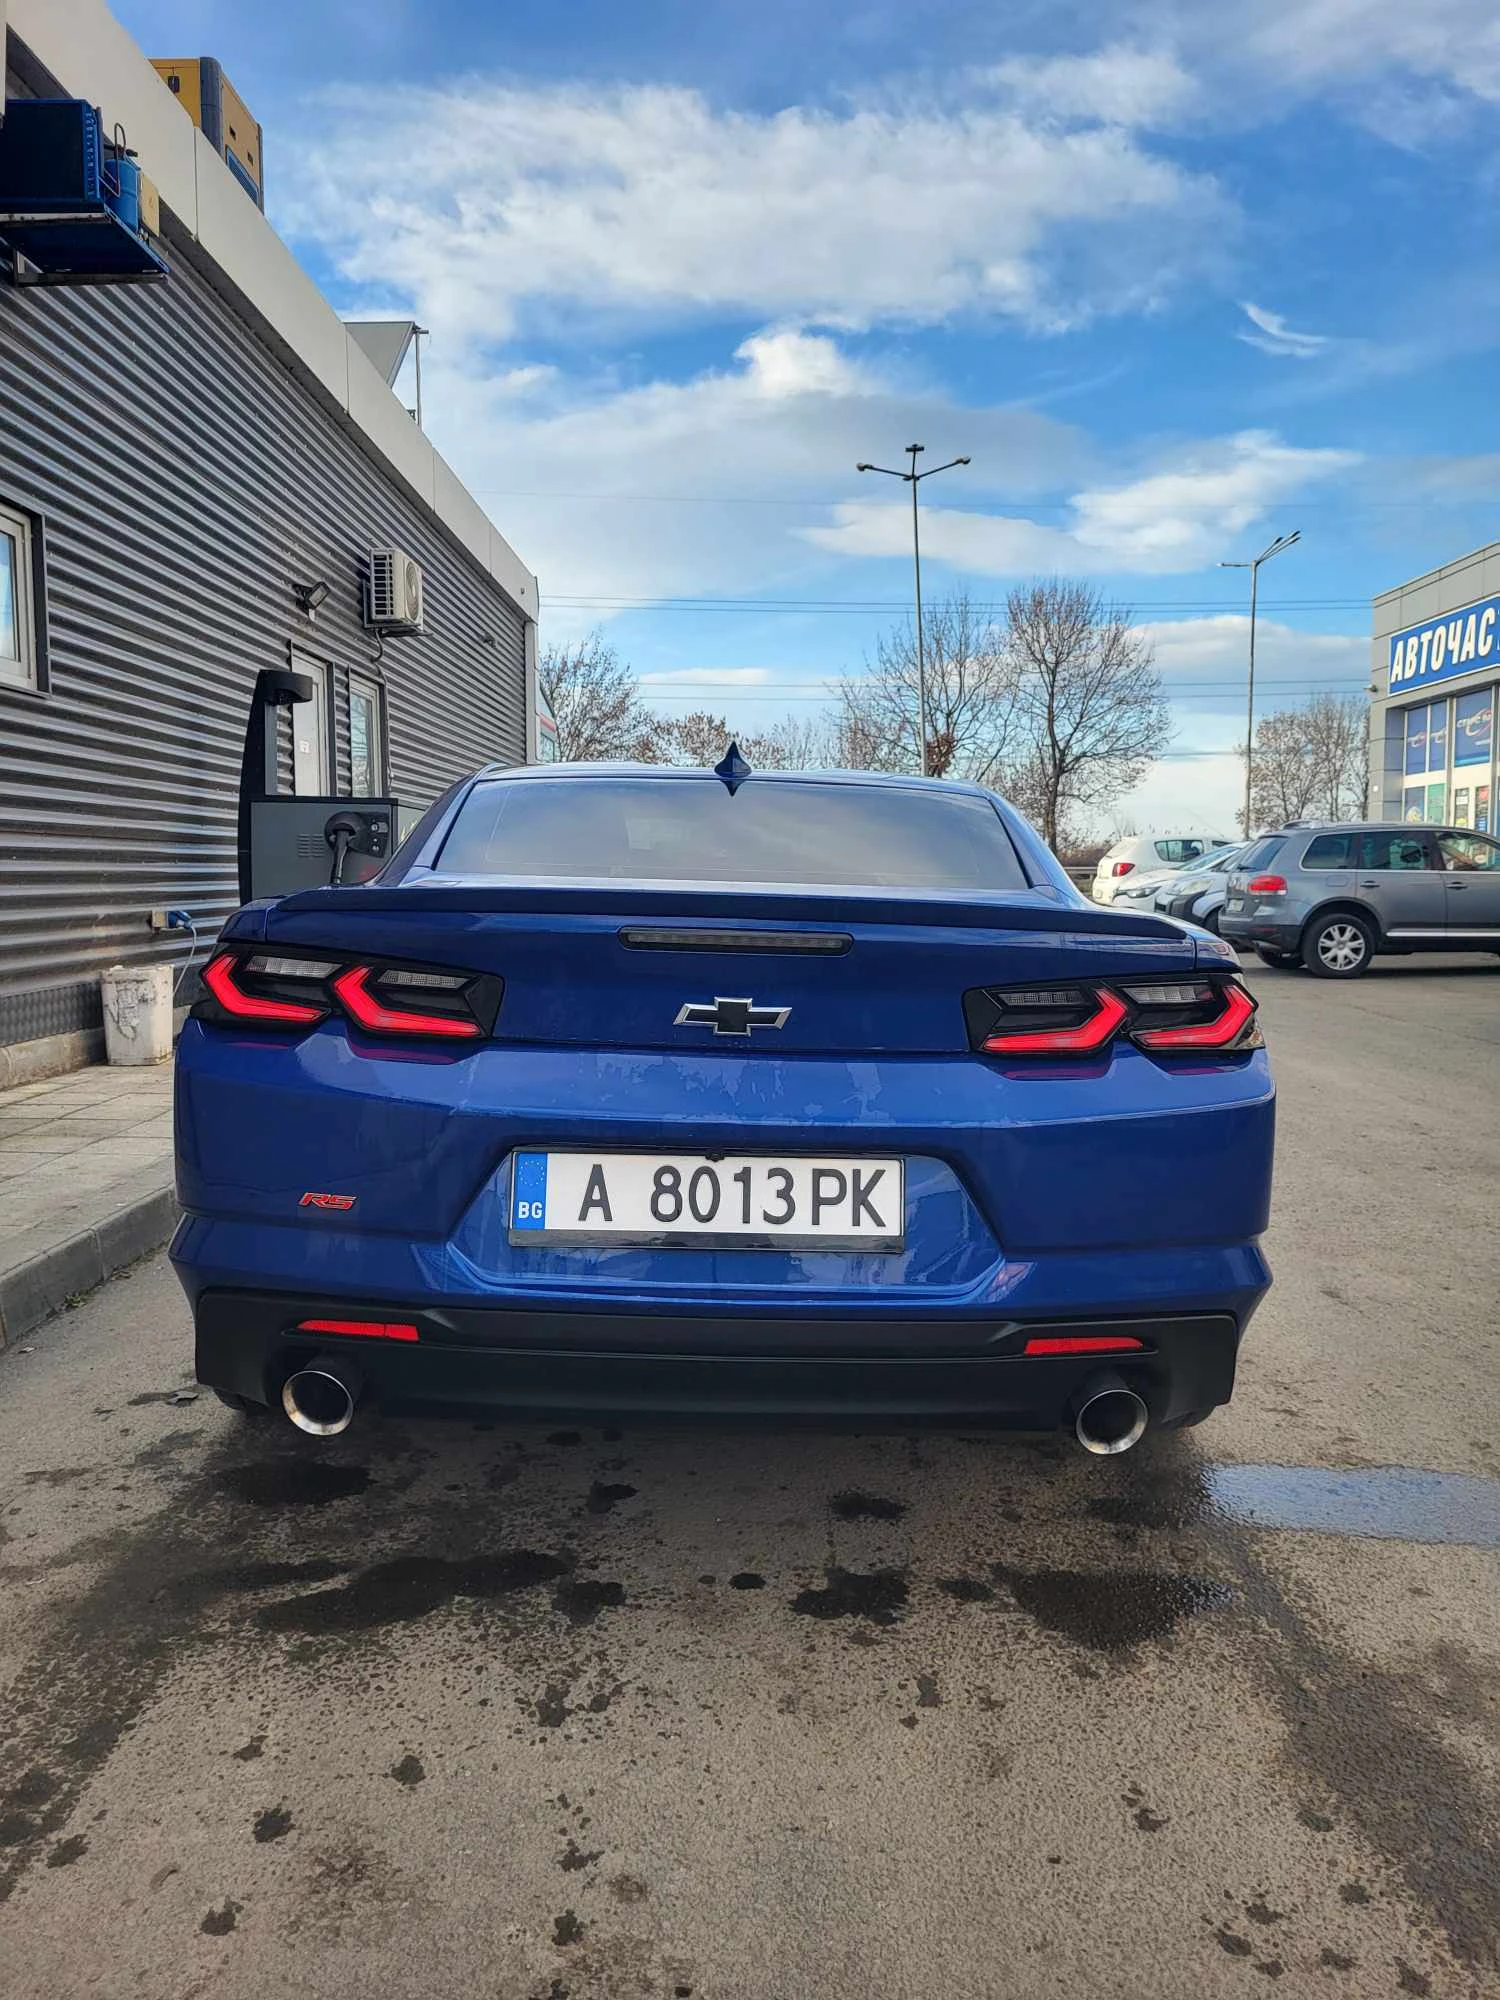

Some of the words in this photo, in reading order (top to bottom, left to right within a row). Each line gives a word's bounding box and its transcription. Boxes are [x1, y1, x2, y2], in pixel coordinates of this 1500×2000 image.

[1390, 607, 1500, 683] АВТОЧАС
[299, 1192, 357, 1210] RS
[518, 1201, 543, 1219] BG
